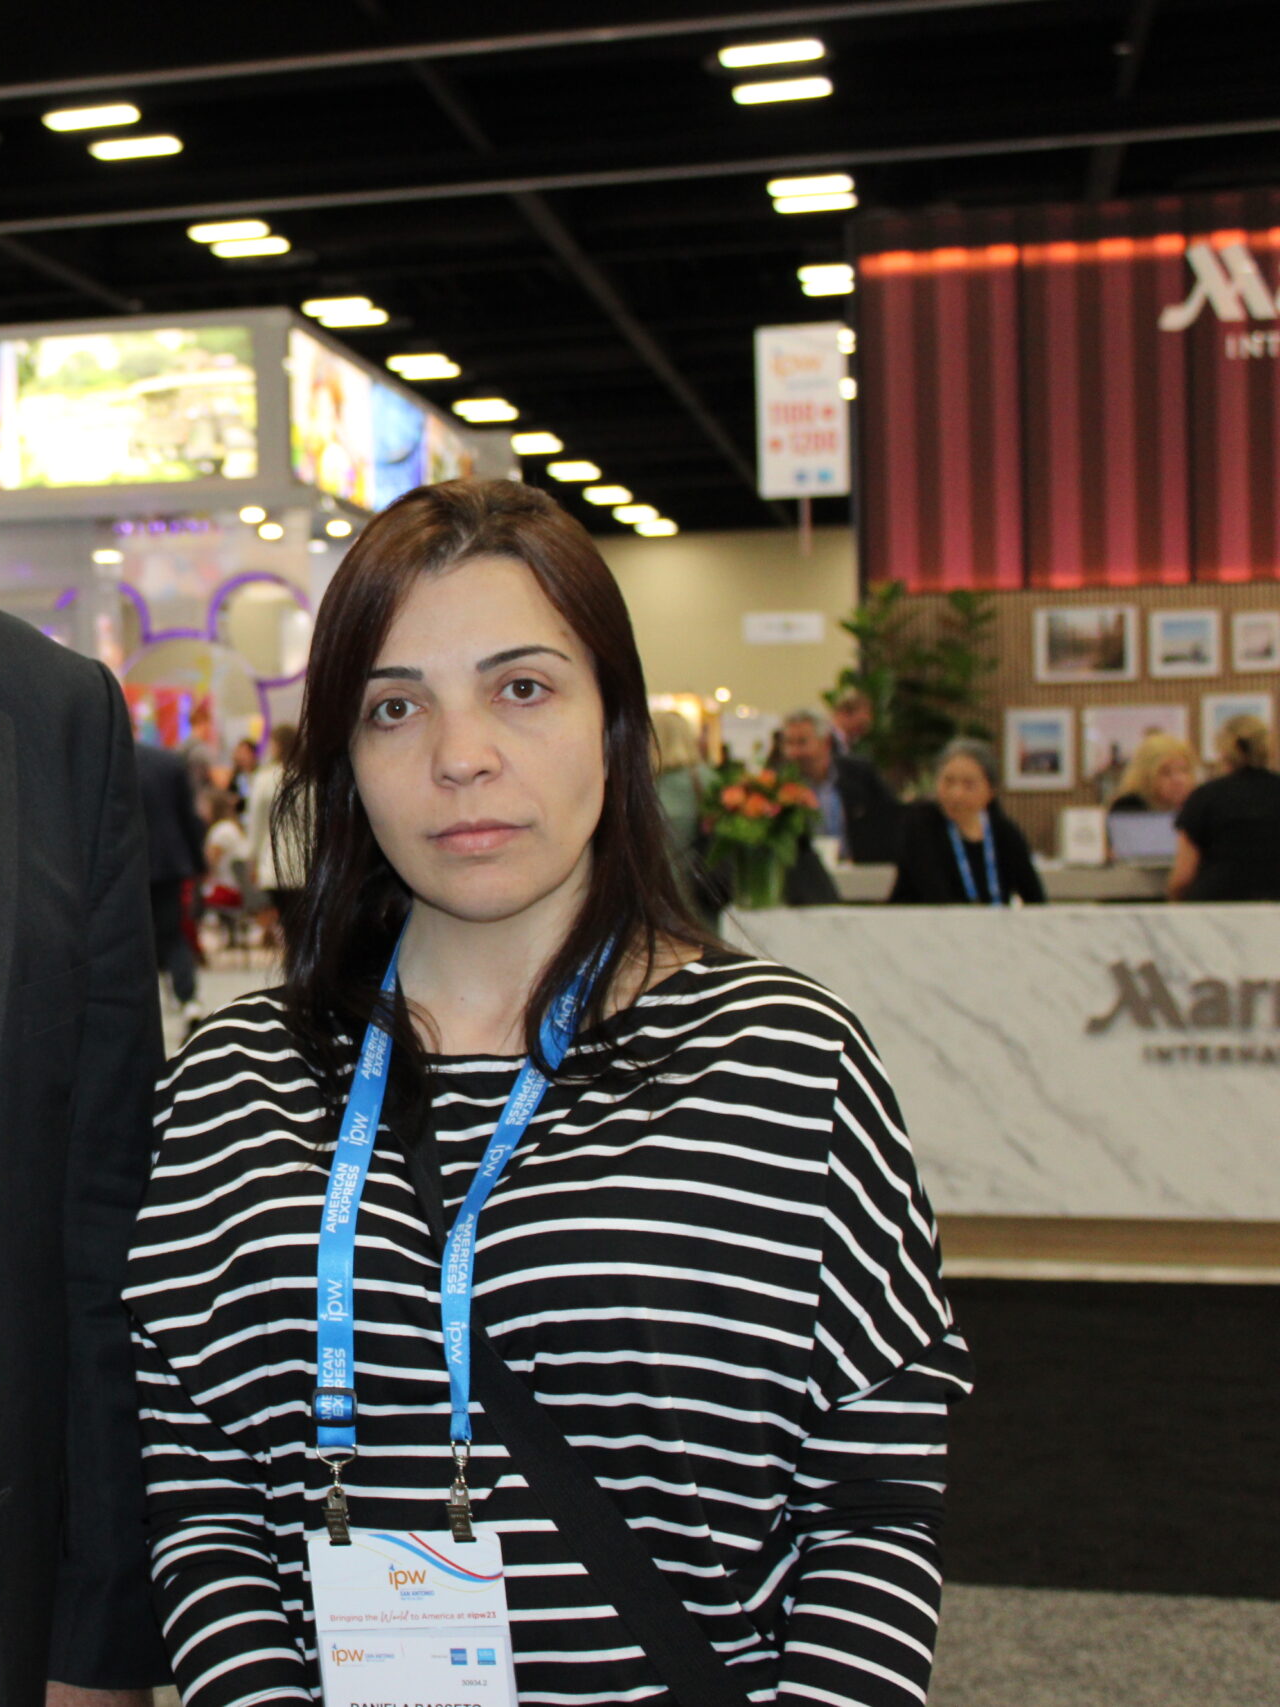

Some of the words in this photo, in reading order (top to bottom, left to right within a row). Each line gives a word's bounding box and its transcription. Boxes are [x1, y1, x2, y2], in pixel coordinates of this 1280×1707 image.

[1158, 242, 1280, 332] M
[1086, 960, 1280, 1035] Mar
[360, 1025, 381, 1081] AMERICA
[371, 1031, 389, 1078] EXPRES
[515, 1067, 547, 1126] MERICAN
[340, 1112, 370, 1147] ipw
[483, 1143, 512, 1177] ipw
[324, 1162, 349, 1233] AMERICAN
[337, 1164, 361, 1225] EXPRESS
[447, 1223, 464, 1295] EXPRESS
[456, 1213, 475, 1295] AMERICAN
[320, 1279, 349, 1322] ipw
[446, 1321, 468, 1365] ipw
[388, 1565, 426, 1591] ipw
[330, 1614, 363, 1622] Bringing
[365, 1613, 378, 1621] the
[410, 1612, 419, 1621] to
[422, 1612, 455, 1620] America
[456, 1612, 465, 1620] at
[332, 1643, 365, 1667] ipw
